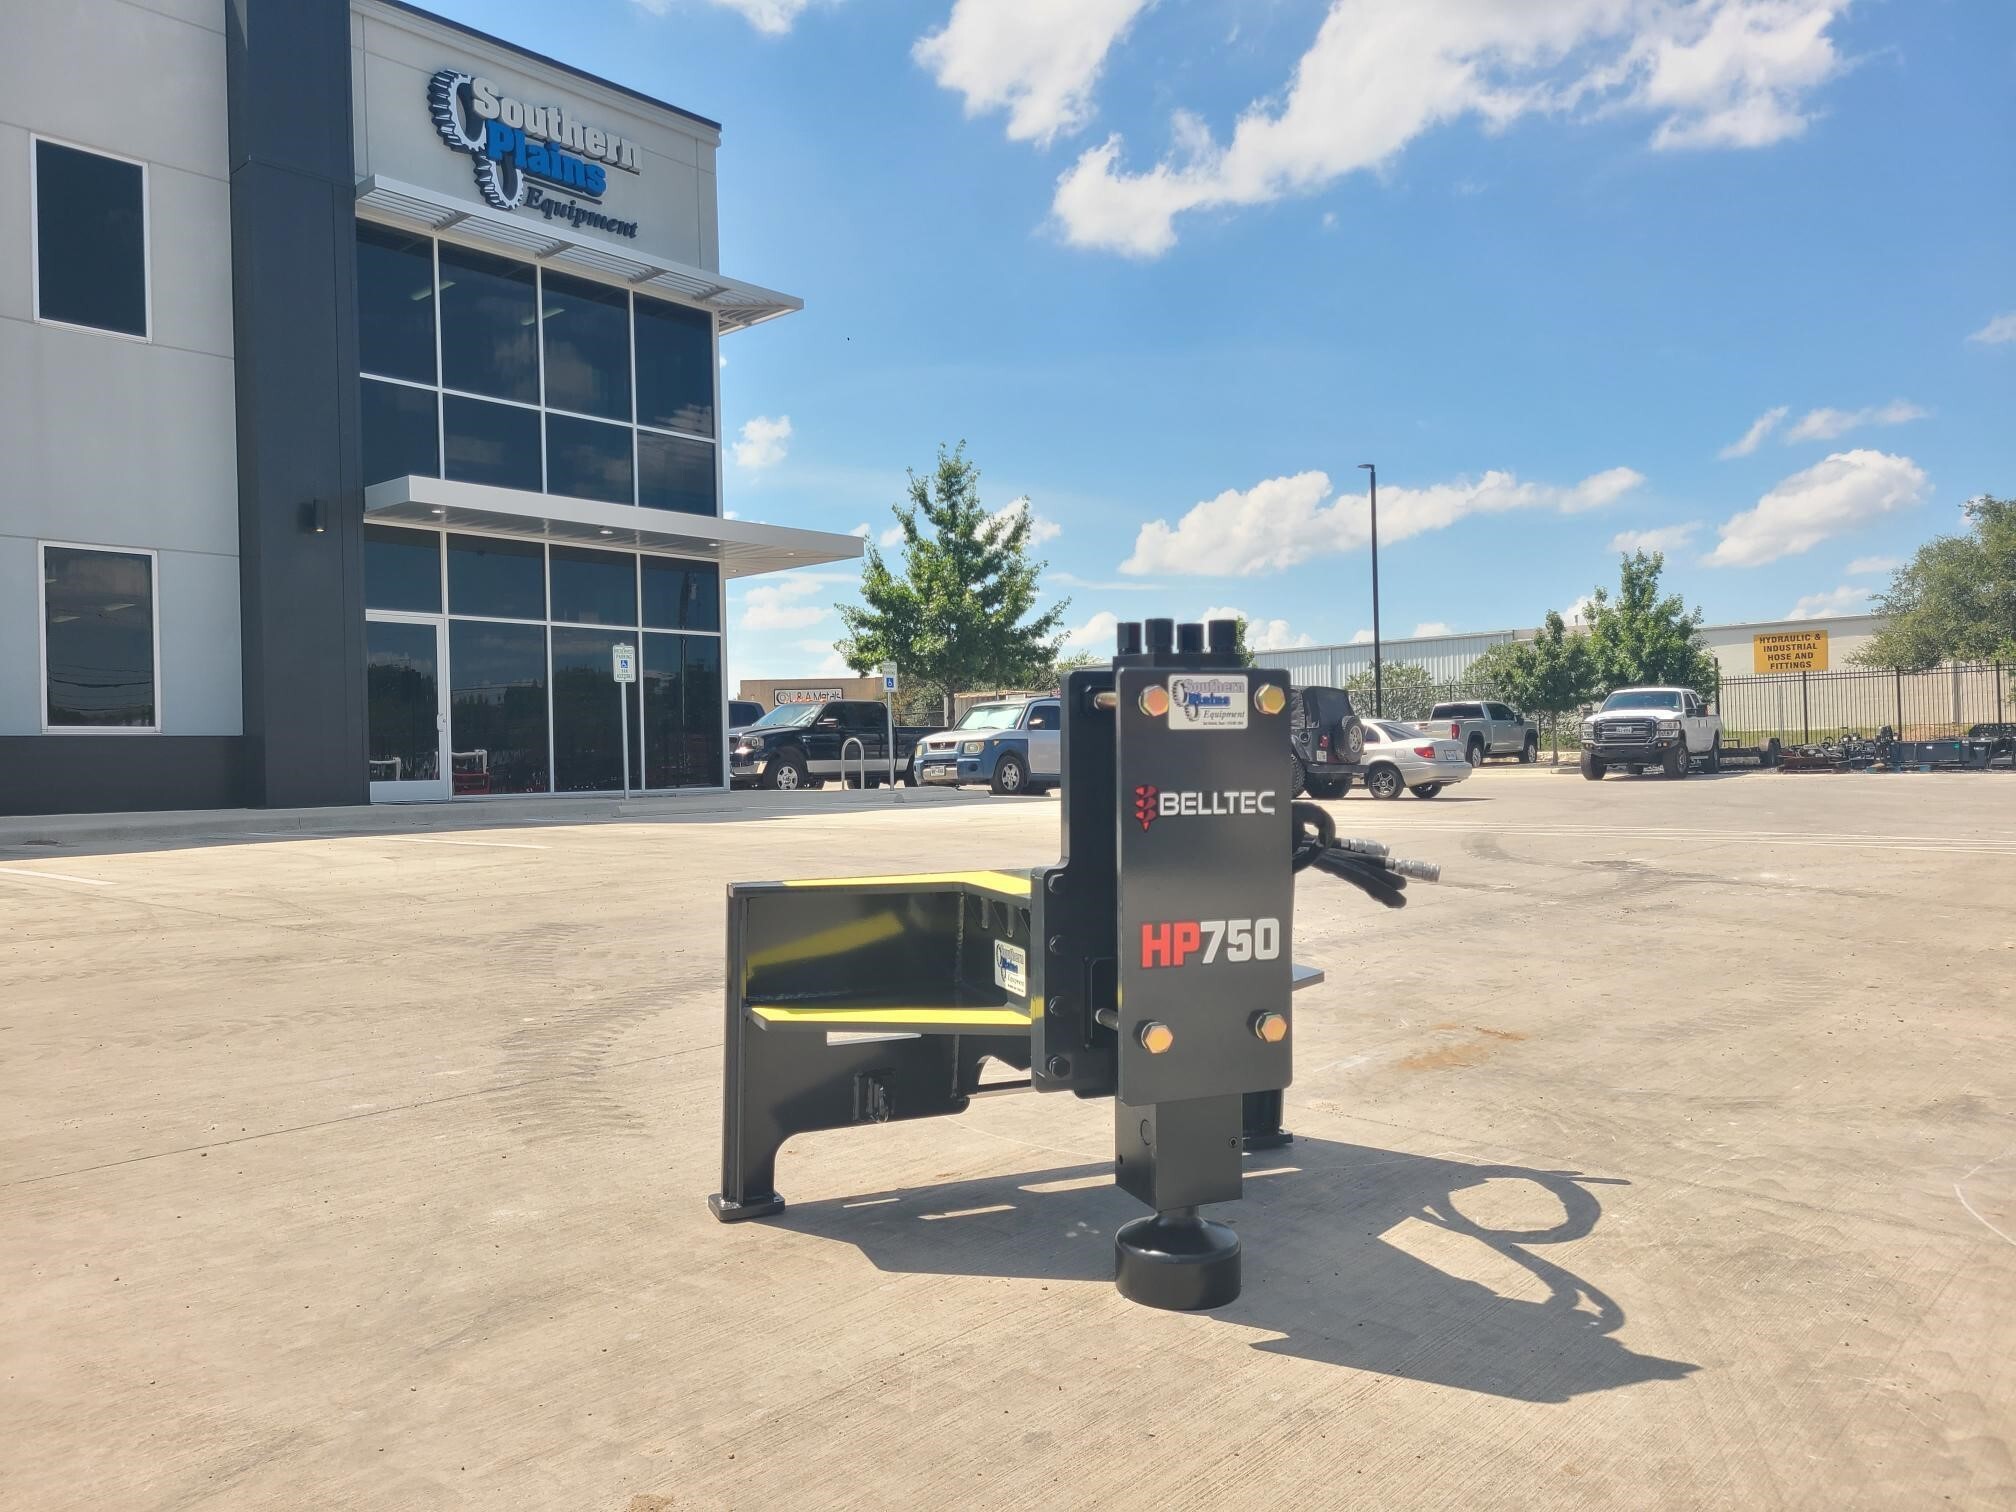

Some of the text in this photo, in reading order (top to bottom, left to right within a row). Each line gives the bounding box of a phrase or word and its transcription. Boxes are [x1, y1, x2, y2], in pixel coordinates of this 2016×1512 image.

[471, 77, 643, 171] Southern
[485, 119, 607, 197] Plains
[523, 186, 638, 239] Equipment
[1760, 634, 1811, 644] HYDRAULIC
[1763, 643, 1818, 652] INDUSTRIAL
[1768, 652, 1814, 661] HOSE AND
[1770, 661, 1812, 670] FITTINGS
[1184, 679, 1245, 693] Southern
[1203, 710, 1245, 720] Equipment
[1159, 791, 1276, 816] BELLTEC
[1142, 918, 1280, 968] HP750
